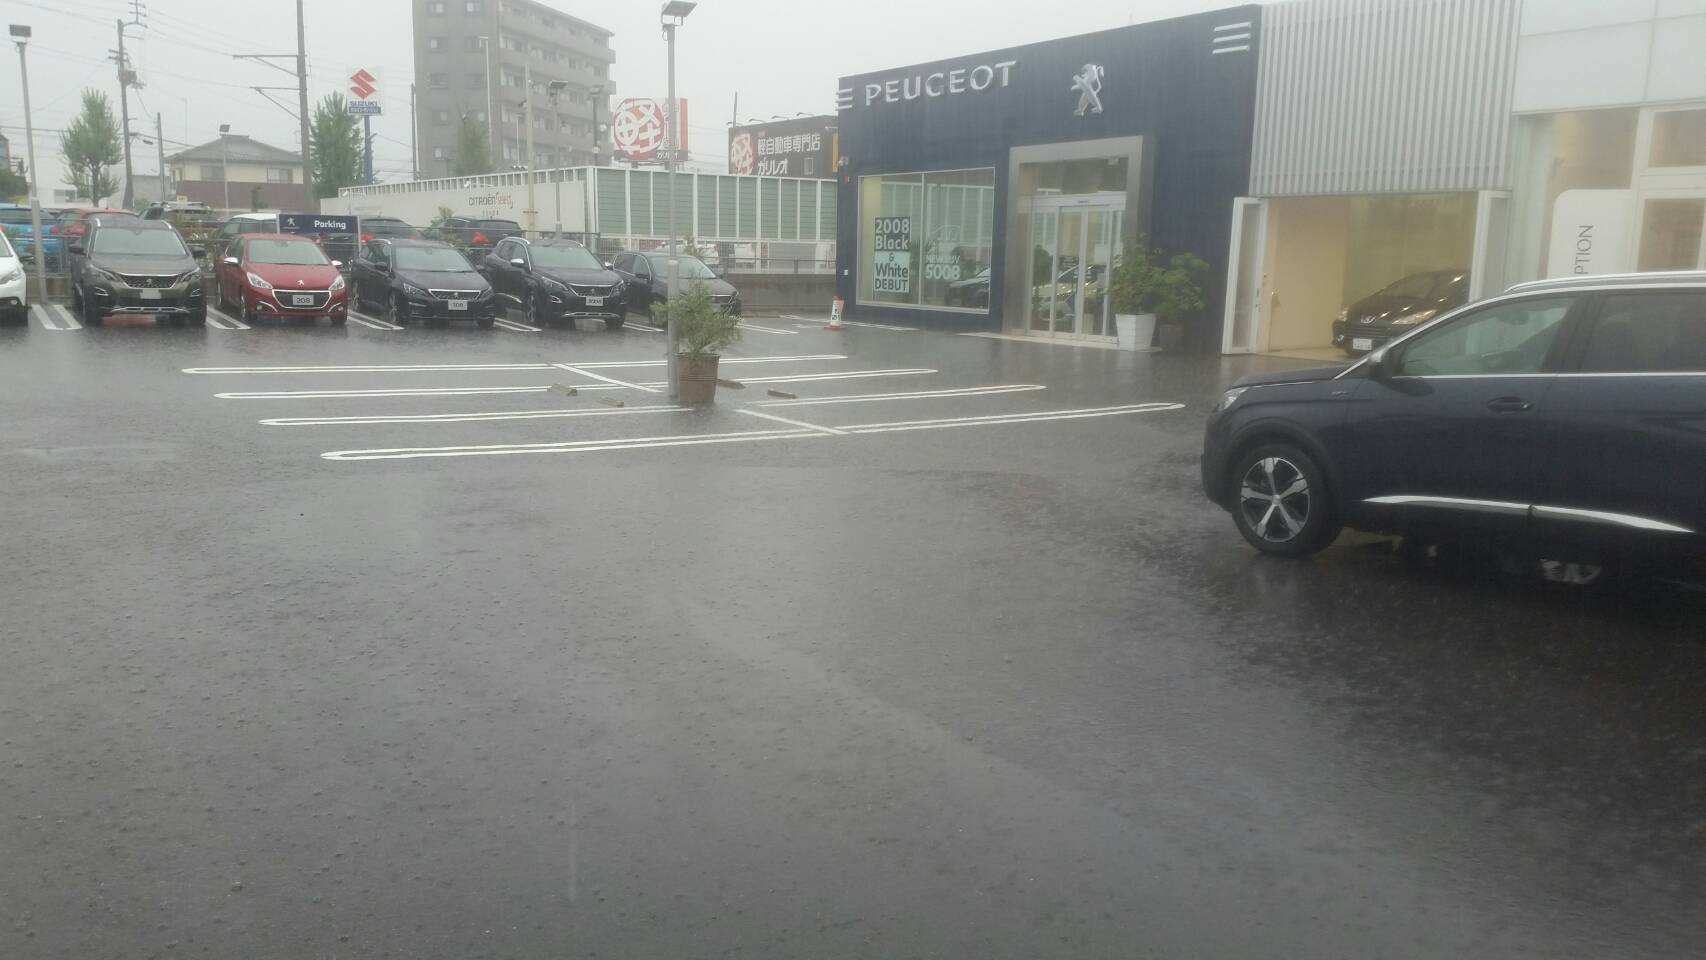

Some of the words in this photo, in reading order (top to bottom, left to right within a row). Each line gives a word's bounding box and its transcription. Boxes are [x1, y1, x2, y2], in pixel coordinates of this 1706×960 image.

[865, 60, 1017, 106] PEUGEOT
[757, 133, 820, 155] 軽自動車専門店
[313, 220, 346, 230] Parking
[876, 219, 909, 234] 2008
[876, 234, 908, 250] Black
[1574, 225, 1593, 274] PTION
[888, 252, 895, 262] &
[876, 263, 909, 278] White
[926, 264, 960, 280] 5008
[875, 278, 908, 291] DEBUT
